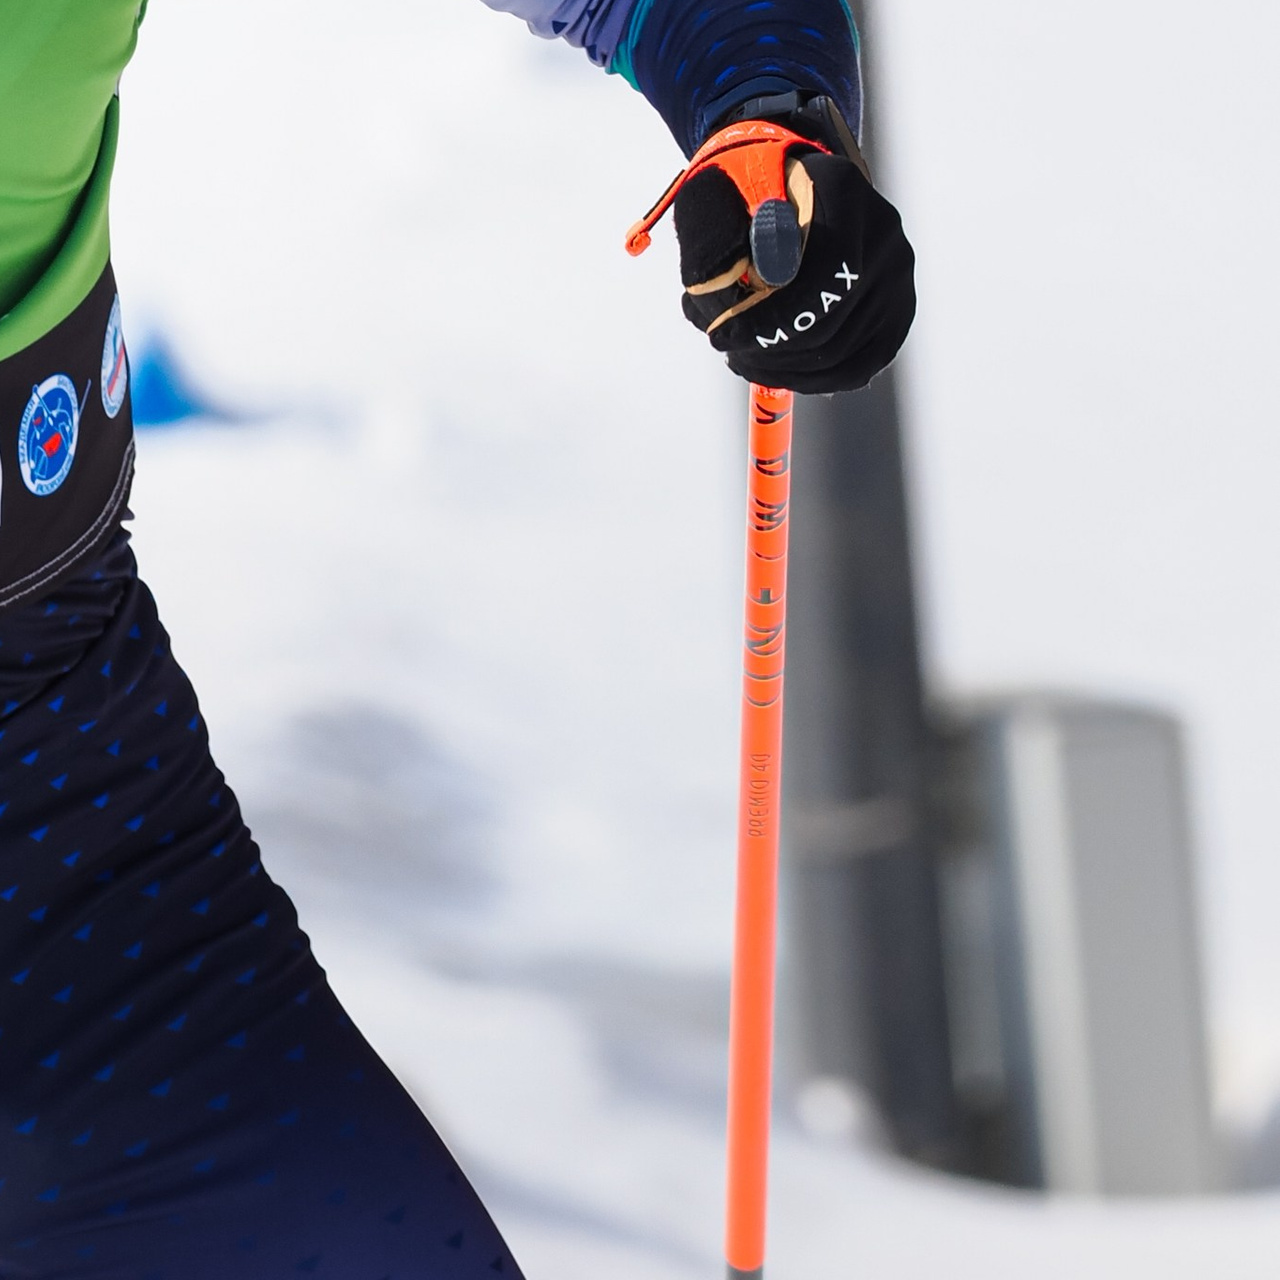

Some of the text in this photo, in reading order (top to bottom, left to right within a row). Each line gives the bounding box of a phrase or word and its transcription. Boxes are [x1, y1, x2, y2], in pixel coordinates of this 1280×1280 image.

[756, 262, 859, 348] MOAX
[748, 754, 771, 837] PREMIO 40
